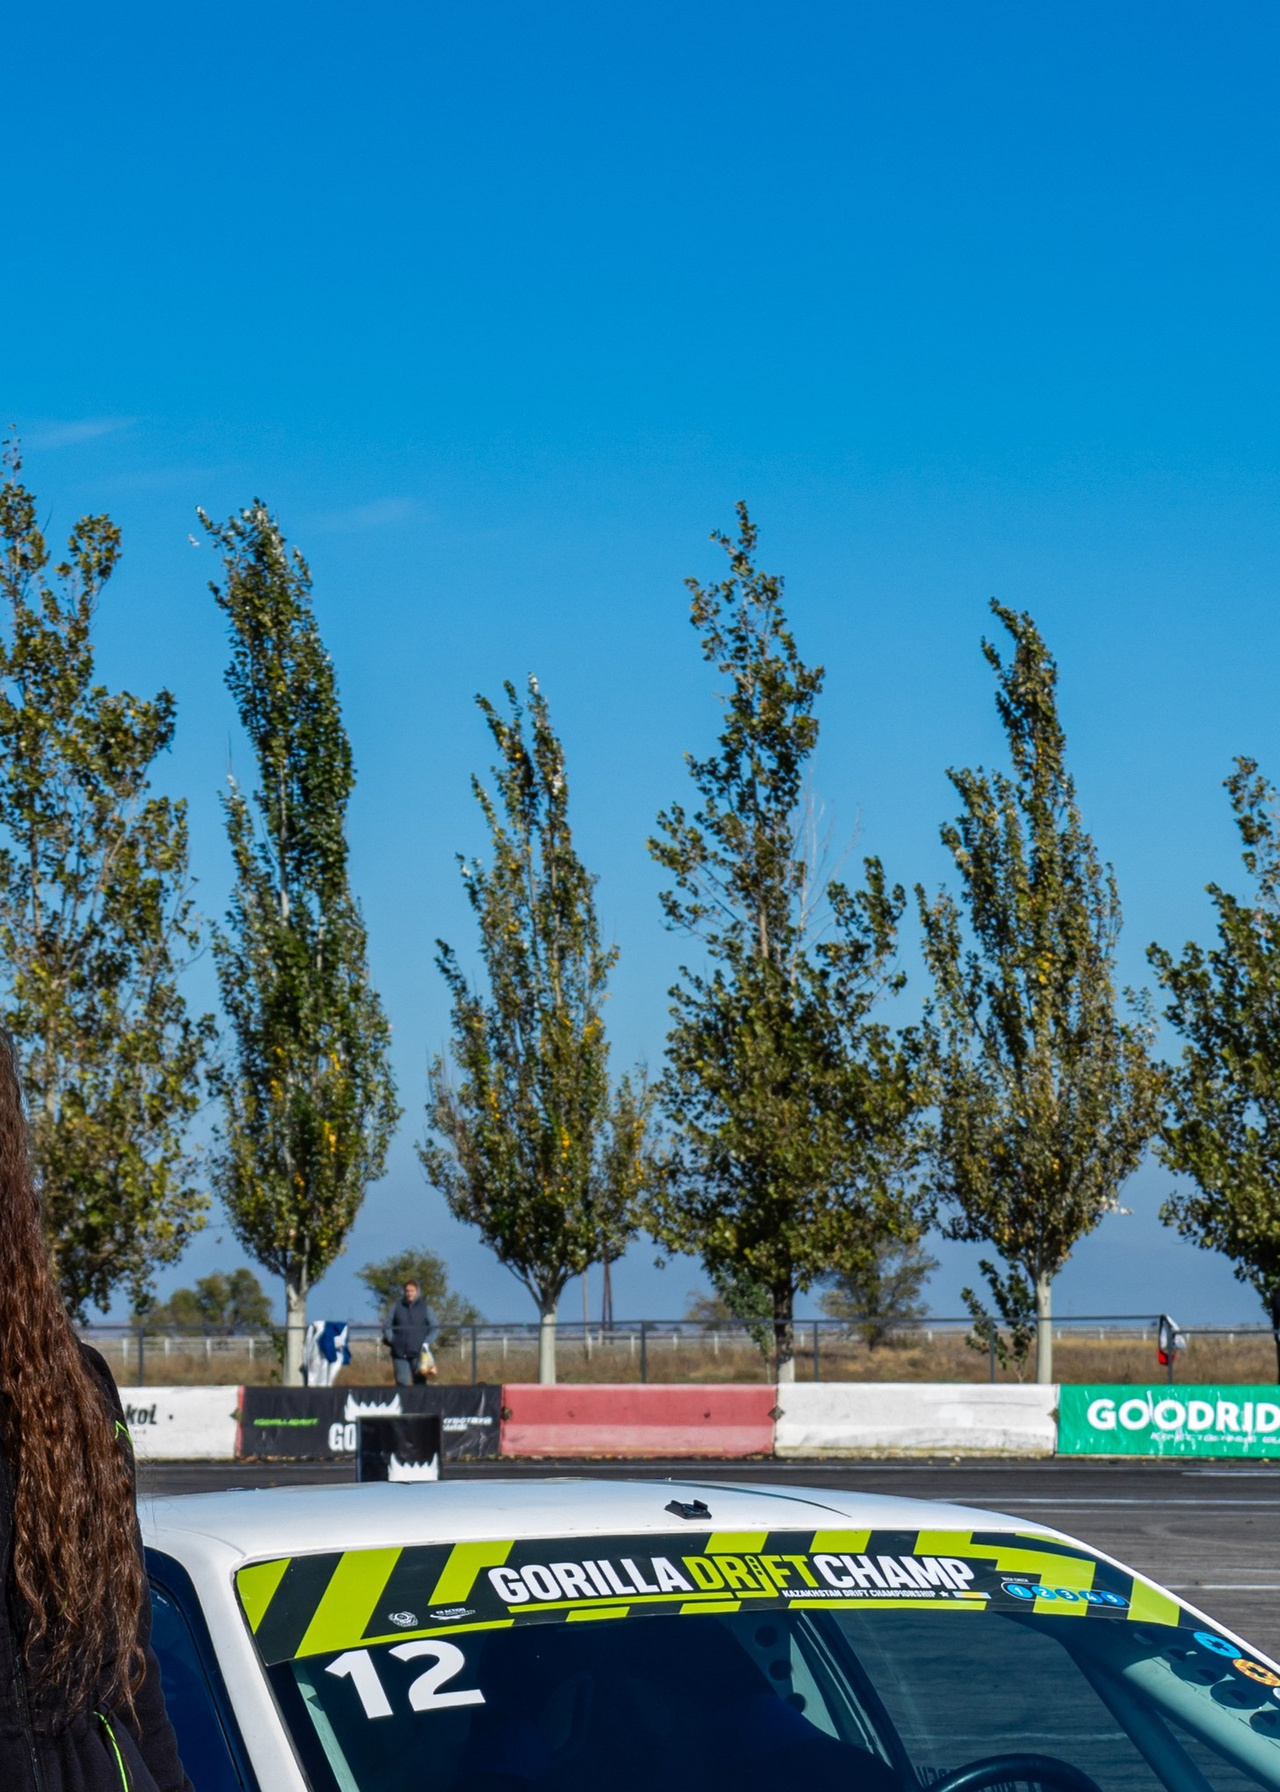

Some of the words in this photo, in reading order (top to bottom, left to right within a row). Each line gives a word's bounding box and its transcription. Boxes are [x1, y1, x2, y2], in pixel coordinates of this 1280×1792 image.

[782, 1589, 842, 1598] KAZAKHSTAN
[843, 1590, 869, 1598] DRIFT
[869, 1590, 936, 1598] CHAMPIONSHIP
[1014, 1587, 1022, 1595] 1
[1039, 1588, 1049, 1597] 2
[1061, 1590, 1074, 1599] 3
[1086, 1592, 1097, 1601] 4
[324, 1639, 486, 1720] 12
